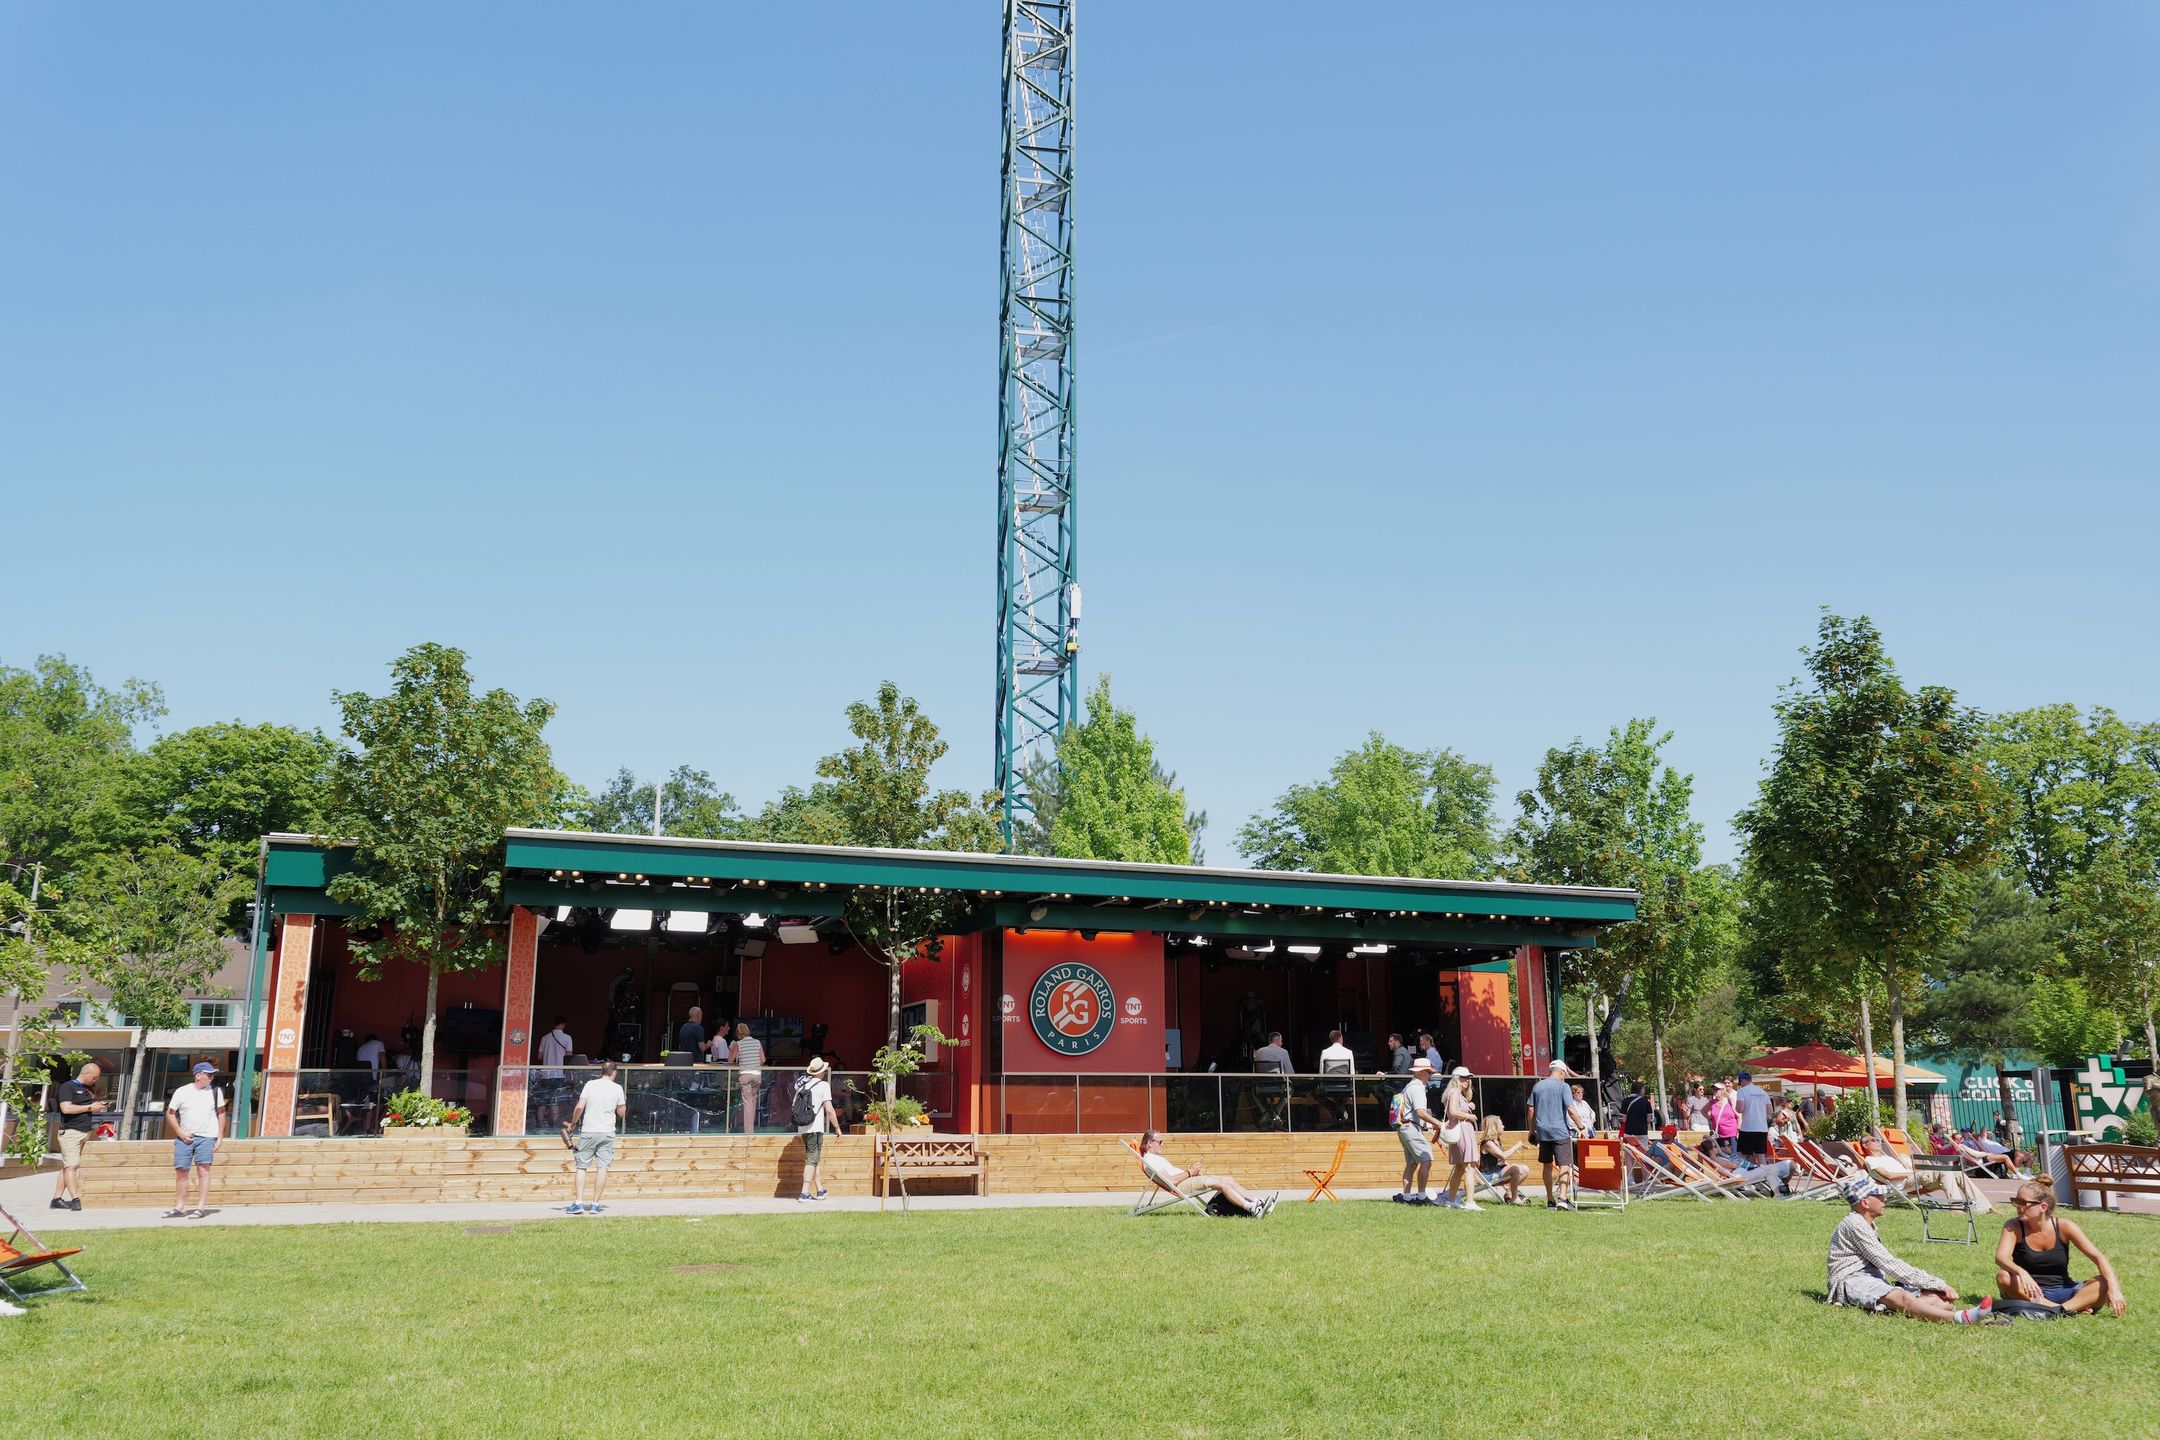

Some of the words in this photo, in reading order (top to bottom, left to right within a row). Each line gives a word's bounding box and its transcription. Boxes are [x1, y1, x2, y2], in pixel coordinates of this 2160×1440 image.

[1035, 967, 1072, 1018] ROLAND
[1076, 968, 1112, 1019] GARROS
[1120, 1017, 1148, 1025] SPORTS
[1047, 1031, 1100, 1049] PARIS
